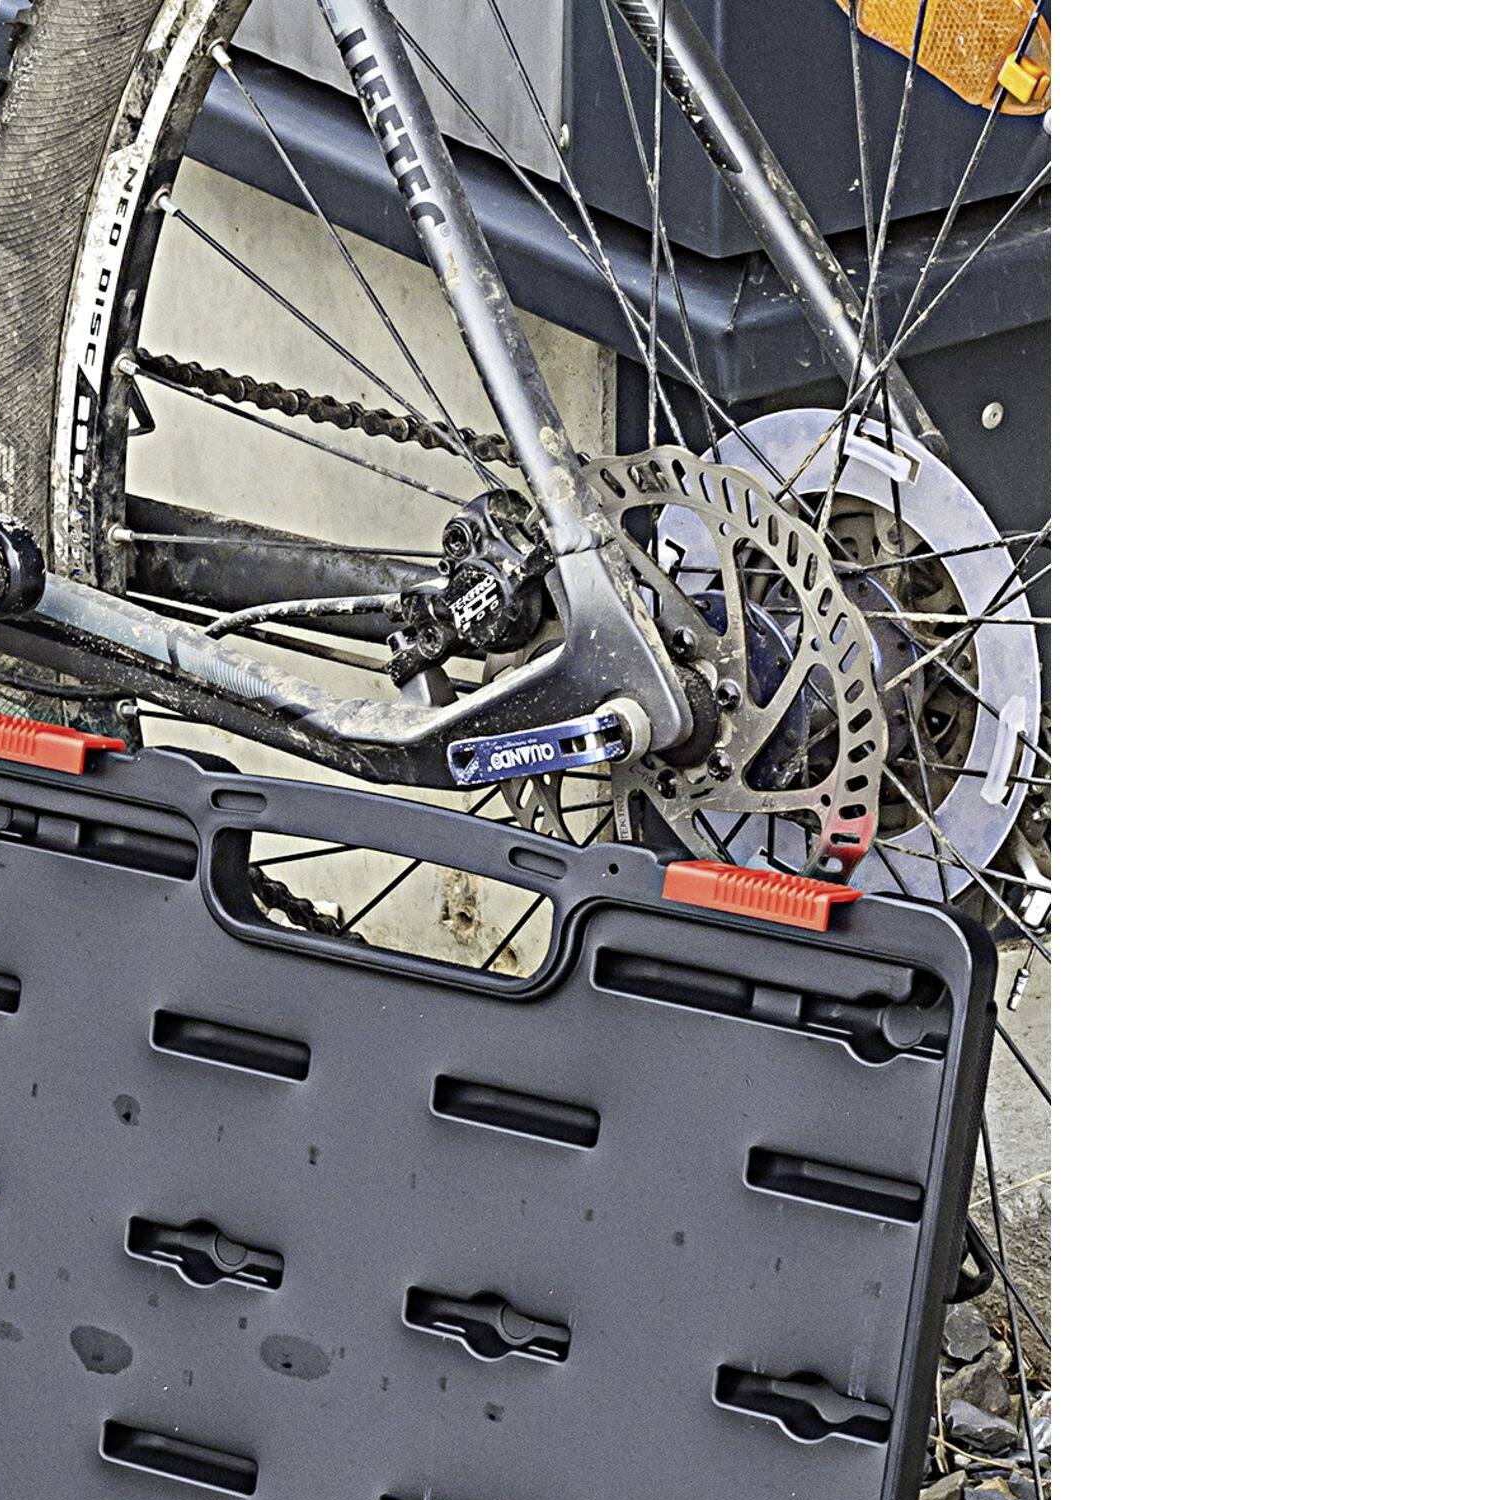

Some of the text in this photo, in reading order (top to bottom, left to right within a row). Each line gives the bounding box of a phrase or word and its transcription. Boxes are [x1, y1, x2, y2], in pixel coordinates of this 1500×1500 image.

[84, 166, 138, 367] NEO DISC
[490, 743, 555, 769] QUANDO
